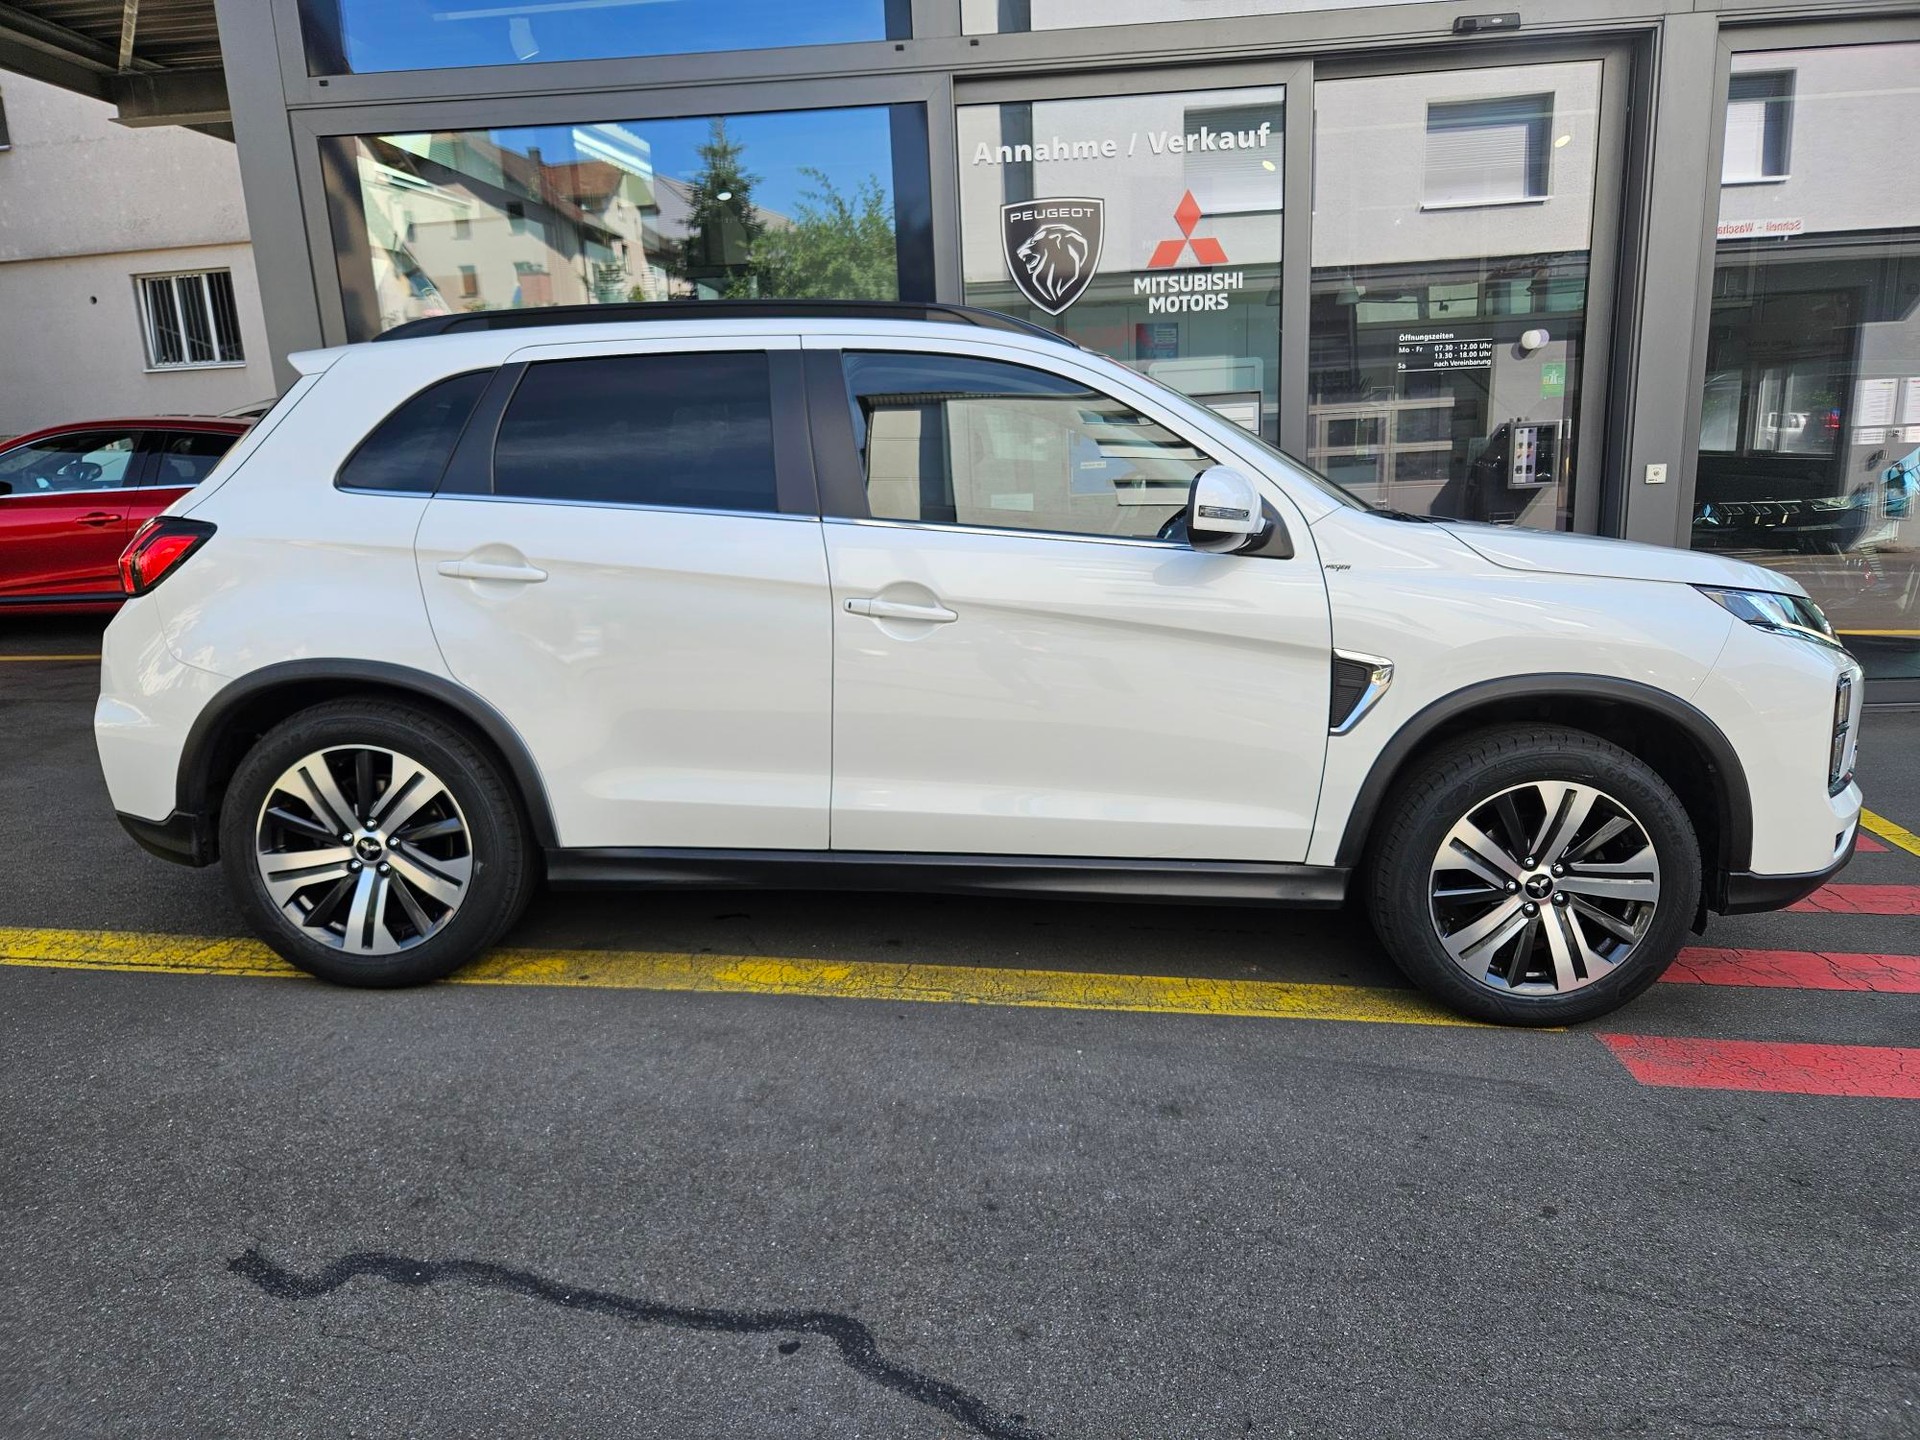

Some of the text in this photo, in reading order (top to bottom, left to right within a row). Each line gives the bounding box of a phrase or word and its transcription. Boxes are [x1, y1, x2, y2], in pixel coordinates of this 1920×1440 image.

[972, 122, 1271, 165] Annahme / Verkauf
[1009, 208, 1095, 223] PEUGEOT
[1133, 272, 1243, 295] MITSUBISHI
[1148, 293, 1229, 314] MOTORS
[1399, 333, 1454, 341] Öffnungszeiten
